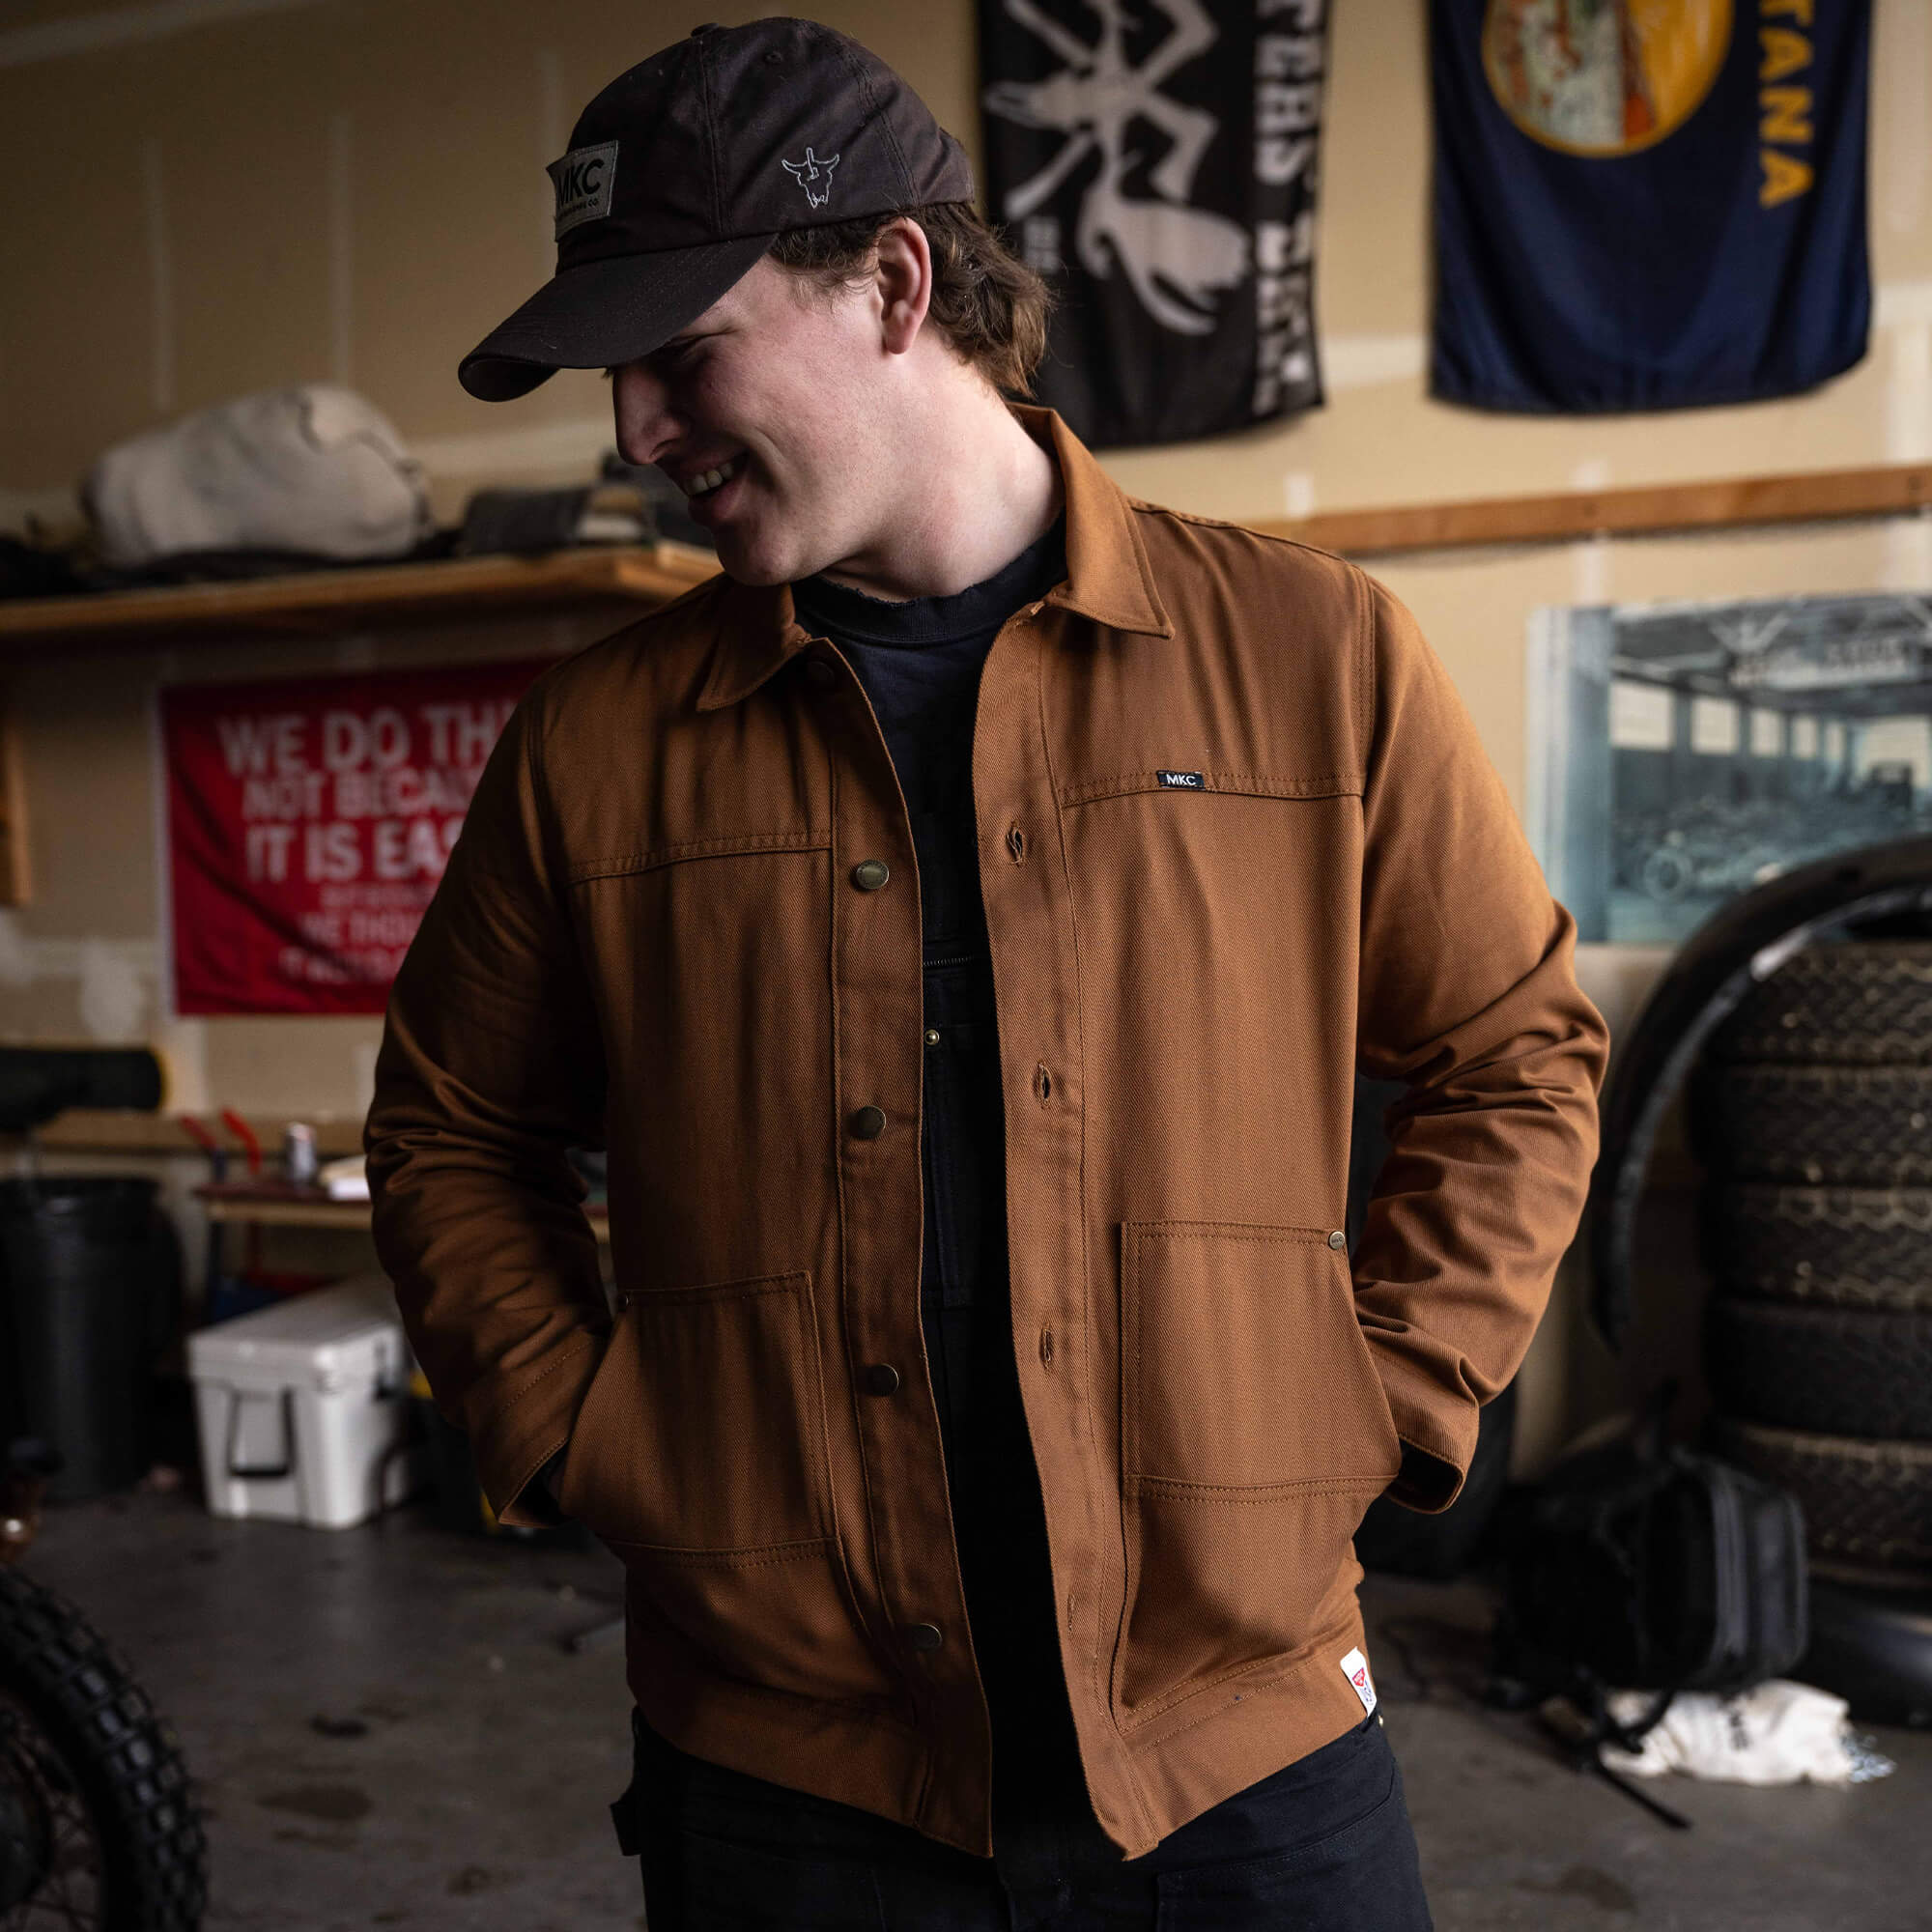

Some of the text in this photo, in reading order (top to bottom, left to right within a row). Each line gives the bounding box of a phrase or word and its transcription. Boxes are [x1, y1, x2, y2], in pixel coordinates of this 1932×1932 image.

[1758, 0, 1814, 209] TANA
[557, 159, 605, 206] MKC
[216, 714, 308, 777] WE
[324, 707, 411, 771] DO
[242, 770, 327, 820] NOT
[1166, 774, 1196, 785] MKC
[245, 825, 296, 881] IT
[304, 821, 363, 881] IS
